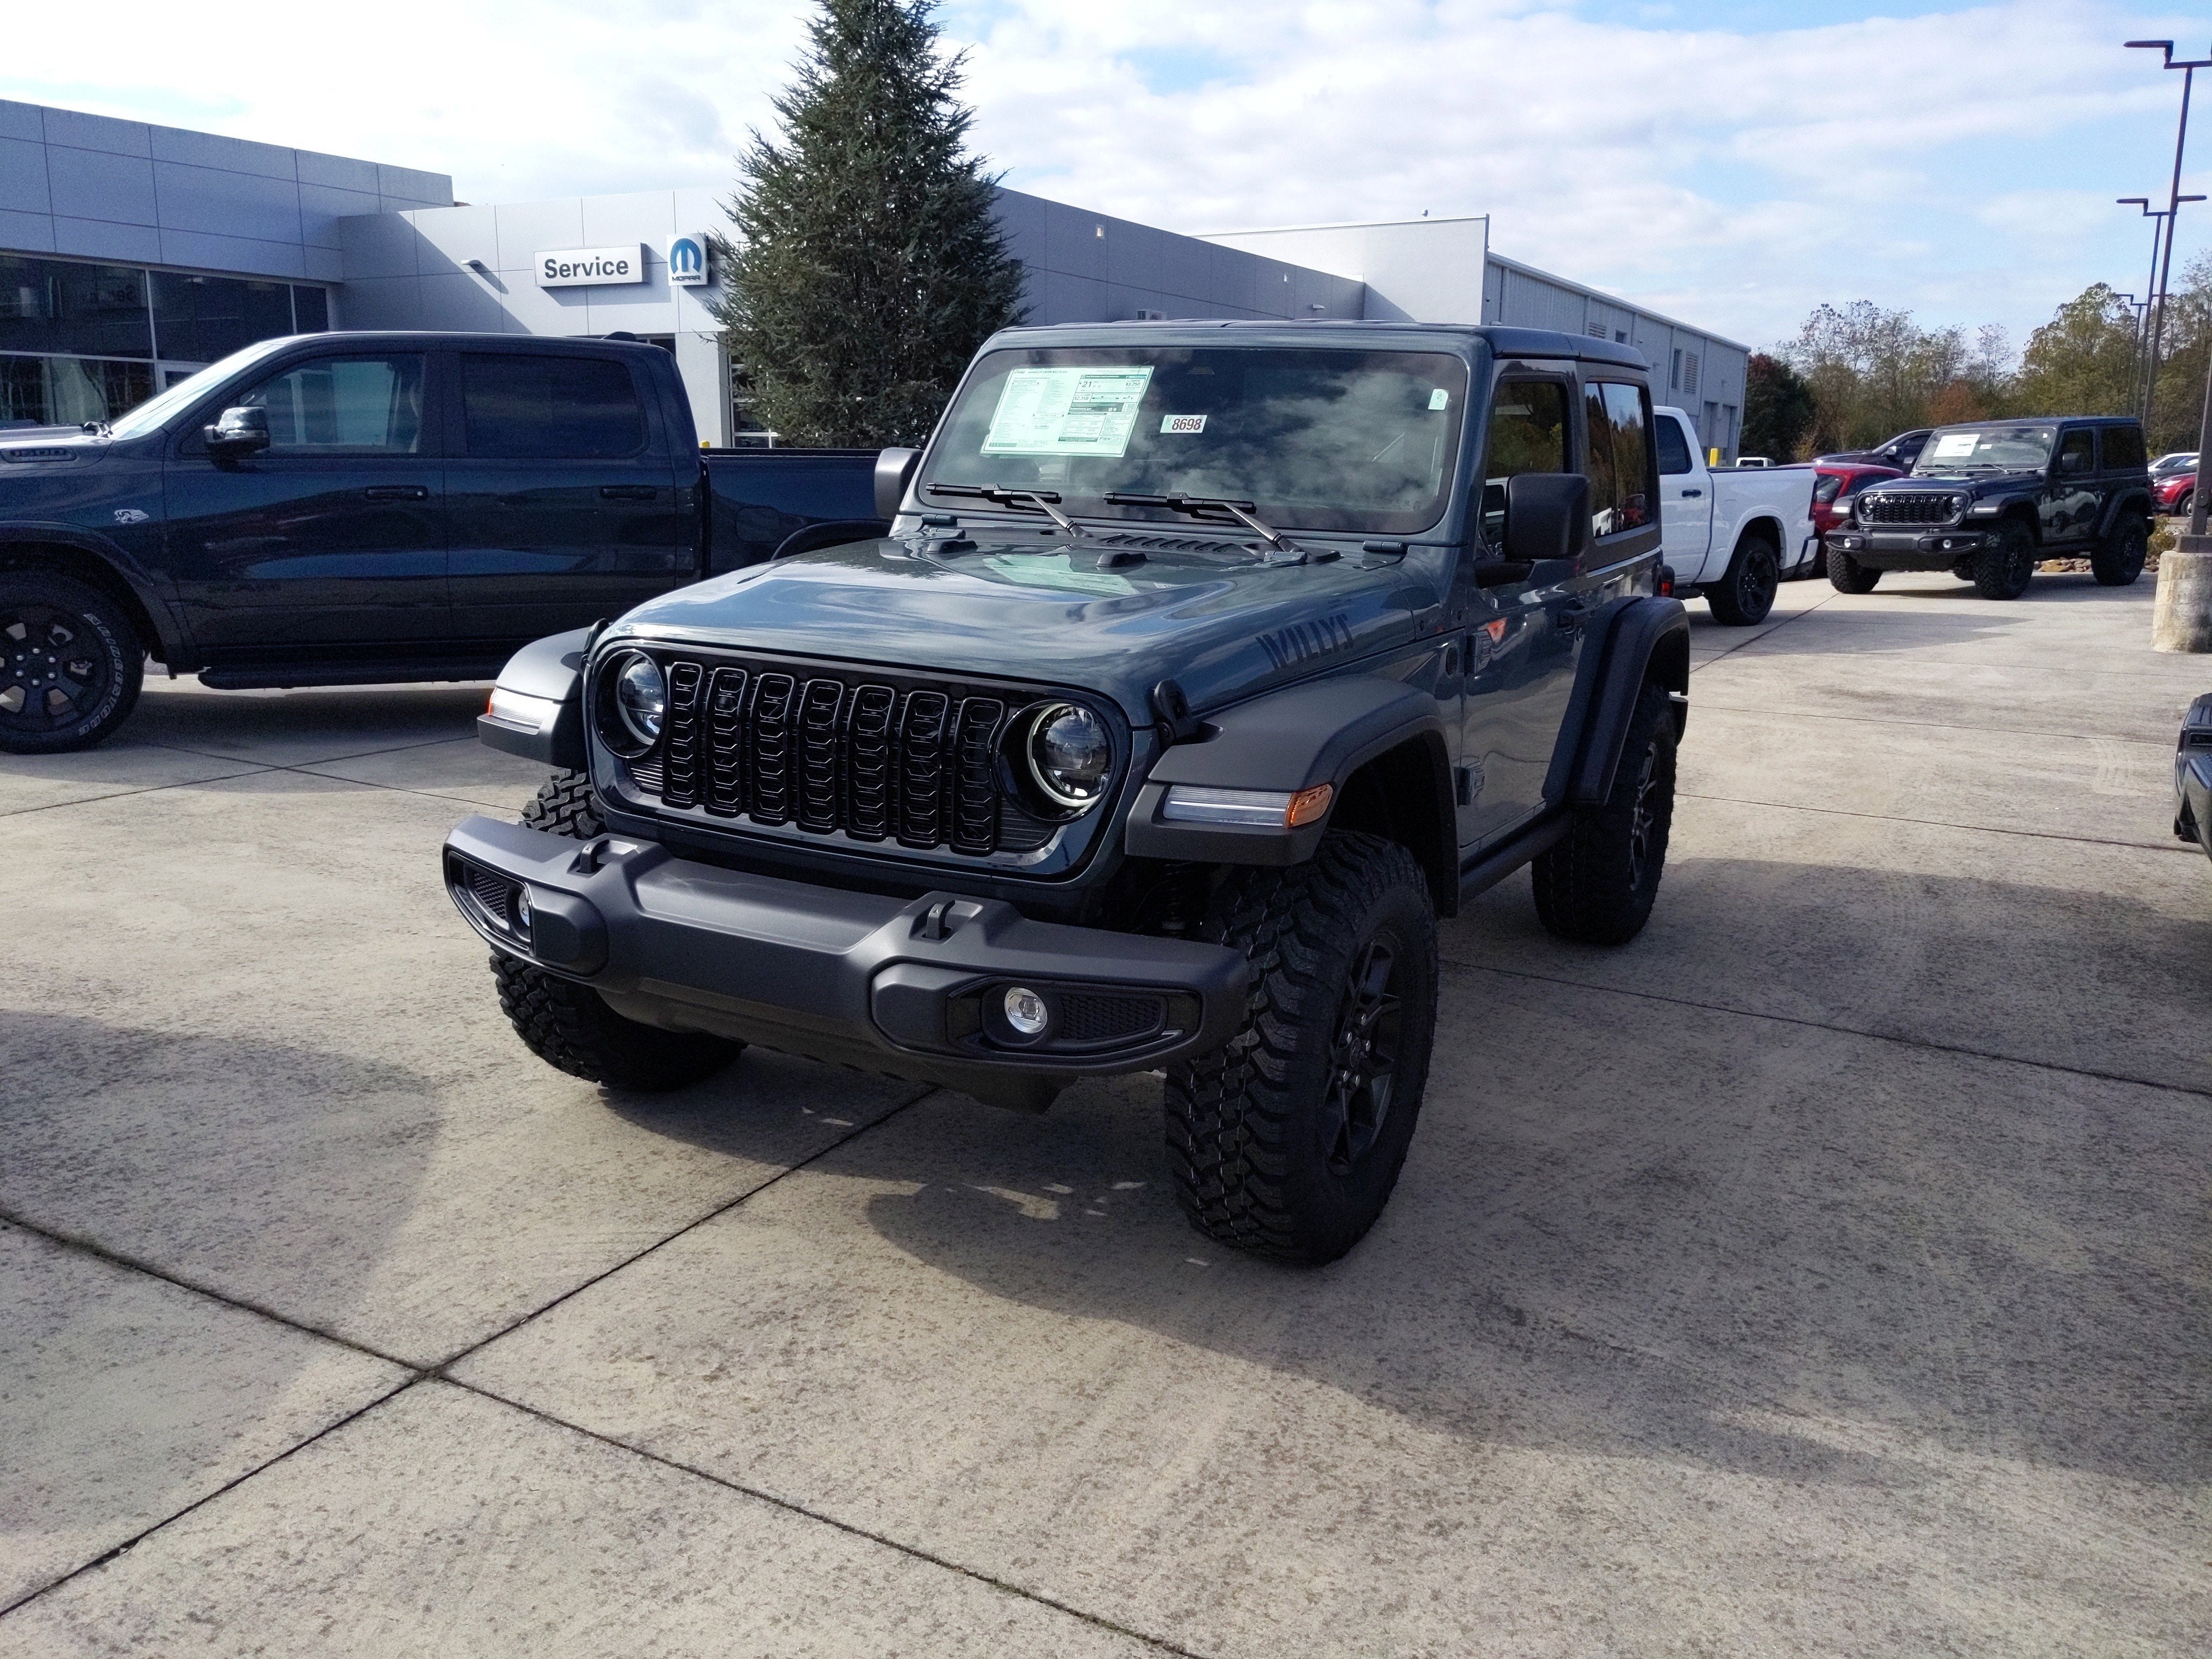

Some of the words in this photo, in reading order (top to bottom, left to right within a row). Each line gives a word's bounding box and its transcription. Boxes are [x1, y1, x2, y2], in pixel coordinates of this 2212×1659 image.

[544, 256, 629, 279] Service
[1172, 418, 1202, 430] 8698
[1255, 613, 1354, 669] WILLYS
